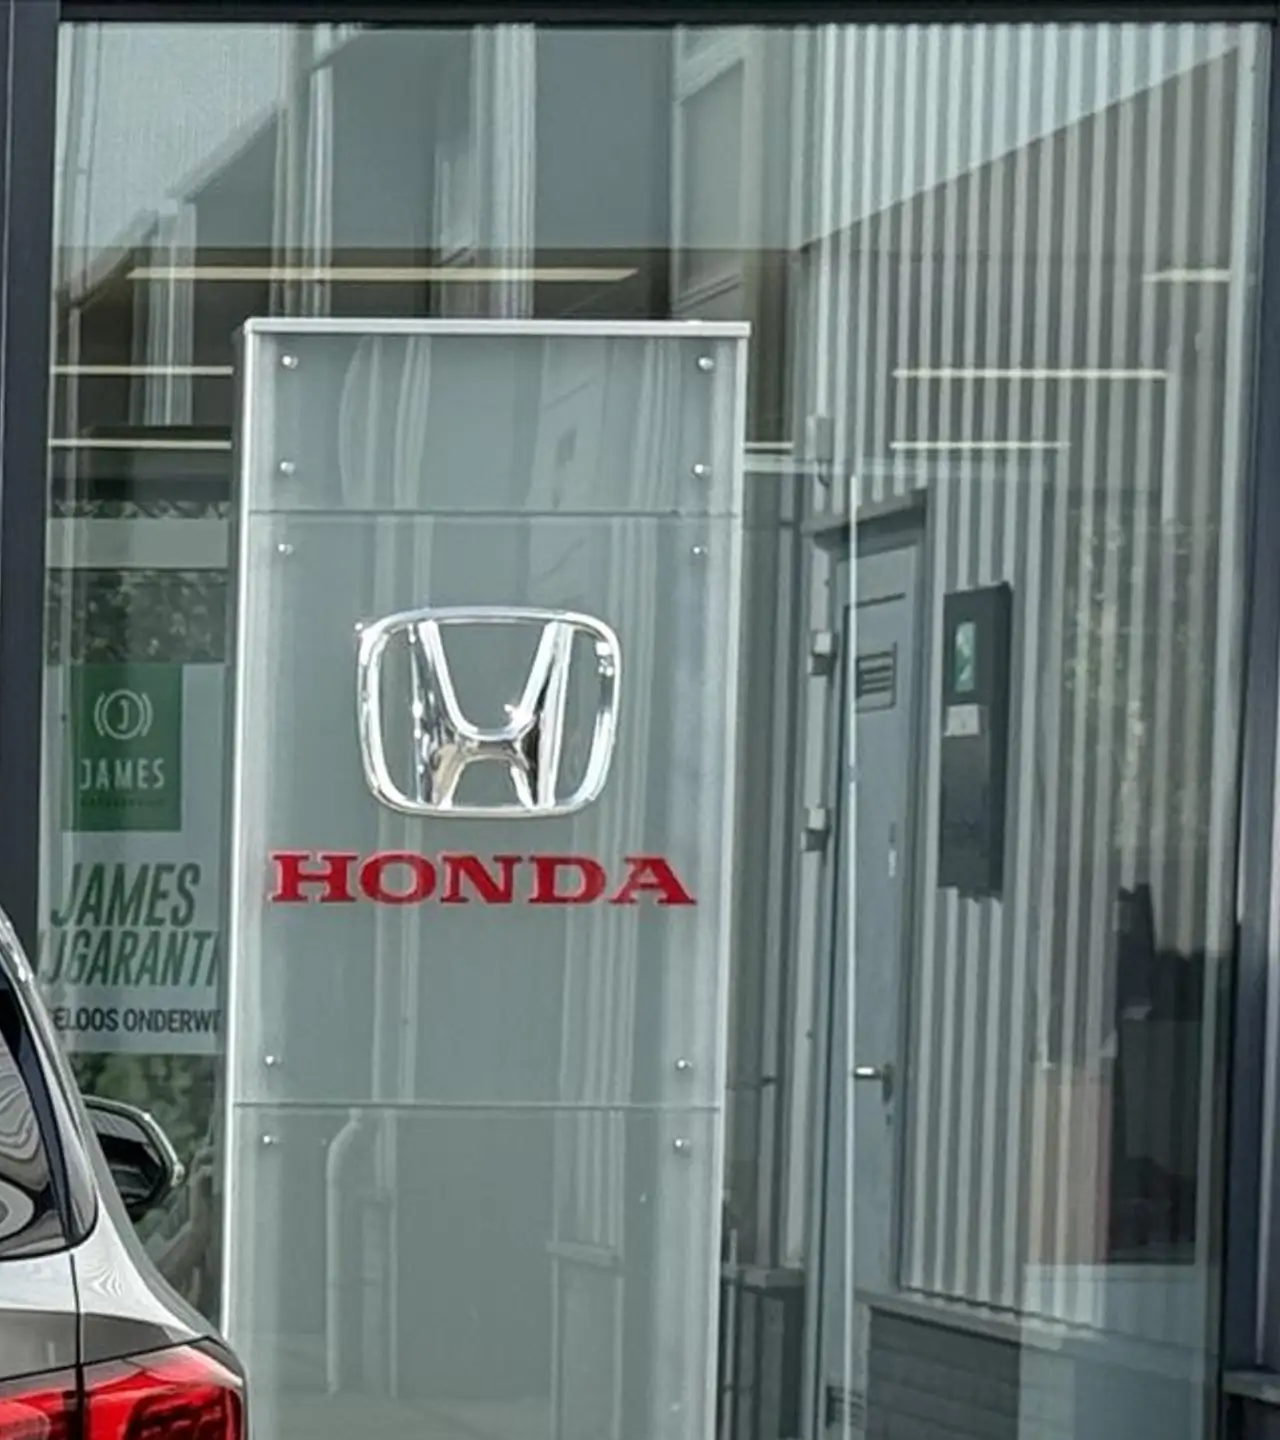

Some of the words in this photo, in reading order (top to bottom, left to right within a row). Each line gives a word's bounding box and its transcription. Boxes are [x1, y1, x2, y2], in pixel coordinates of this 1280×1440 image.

[79, 758, 166, 791] JAMES
[50, 862, 202, 928] JAMES
[269, 850, 699, 906] HONDA
[51, 1007, 120, 1033] ELOOS
